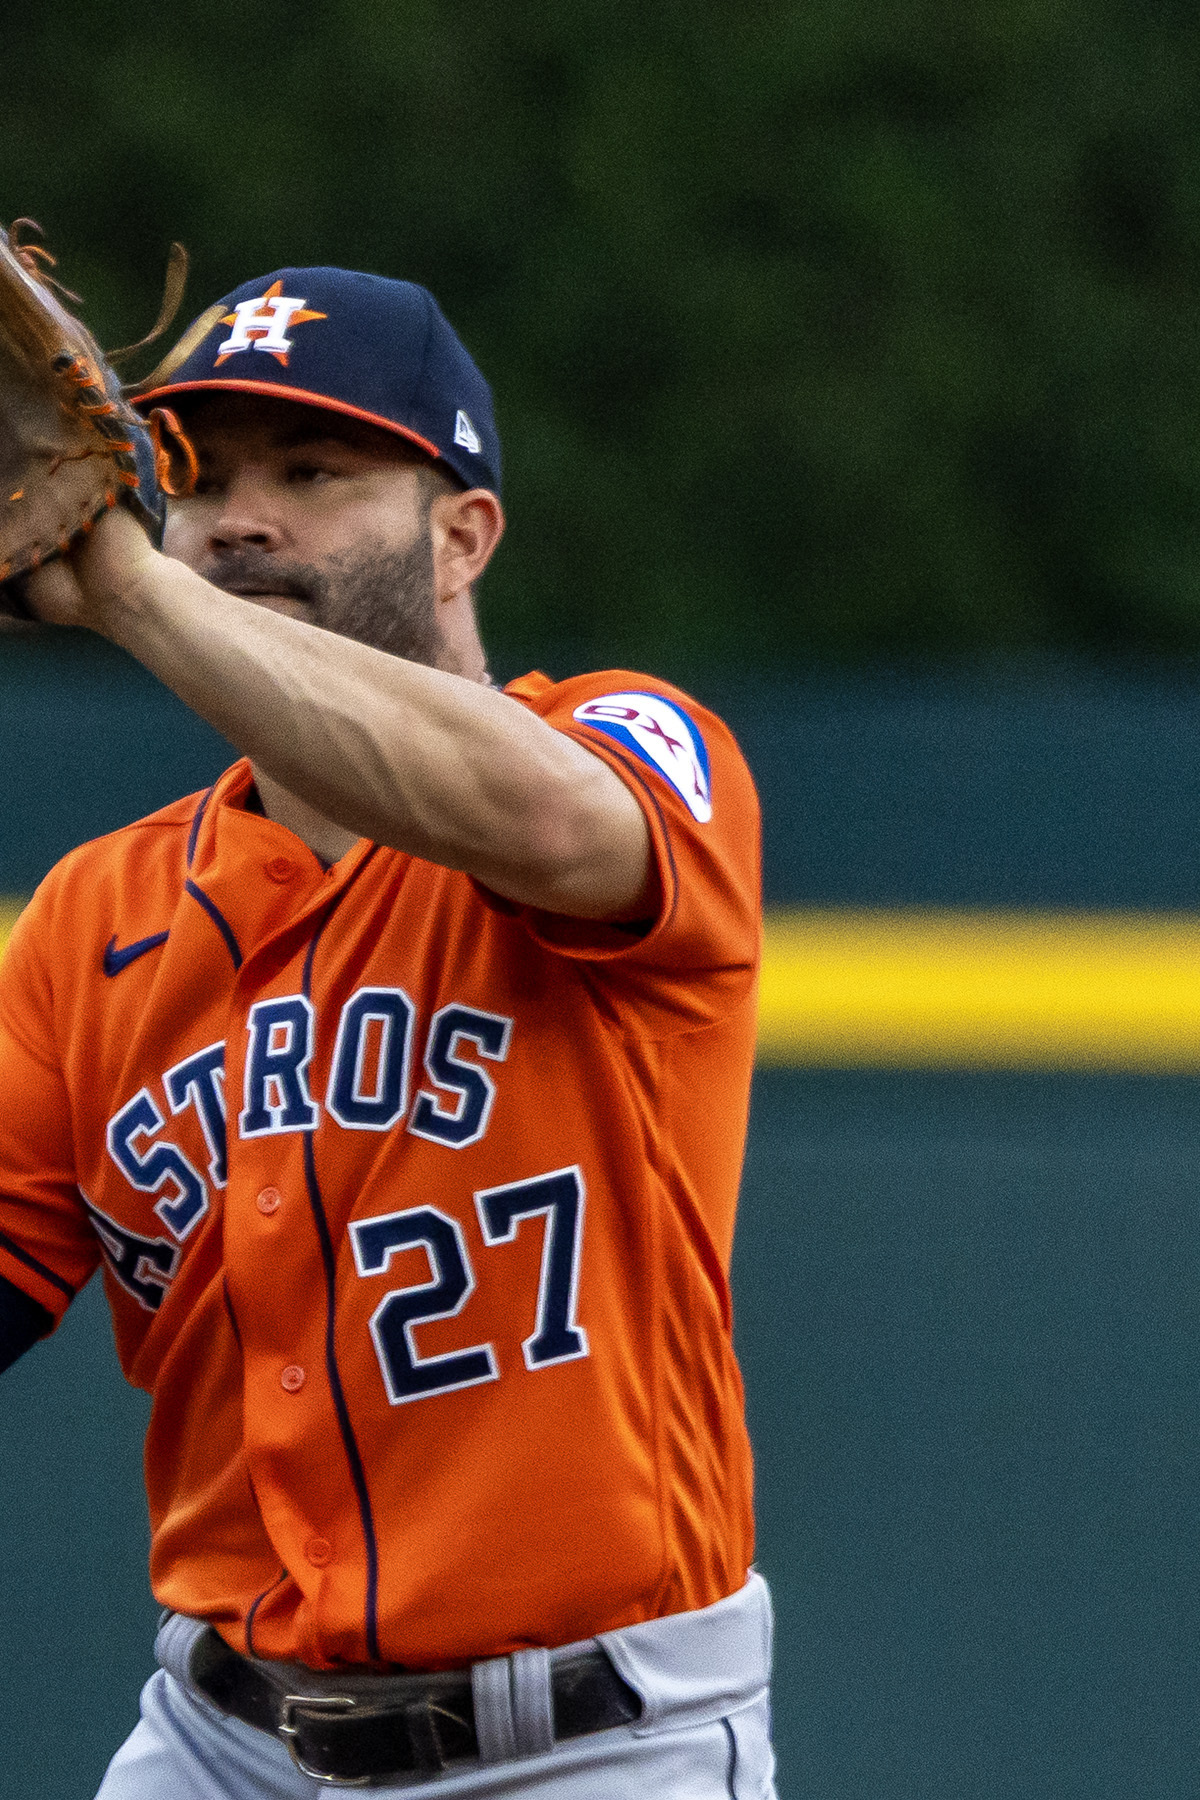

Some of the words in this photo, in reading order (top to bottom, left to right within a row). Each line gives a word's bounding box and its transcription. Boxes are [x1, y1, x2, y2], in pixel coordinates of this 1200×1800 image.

[217, 296, 307, 355] H
[77, 986, 514, 1313] ASTROS
[348, 1164, 590, 1406] 27
